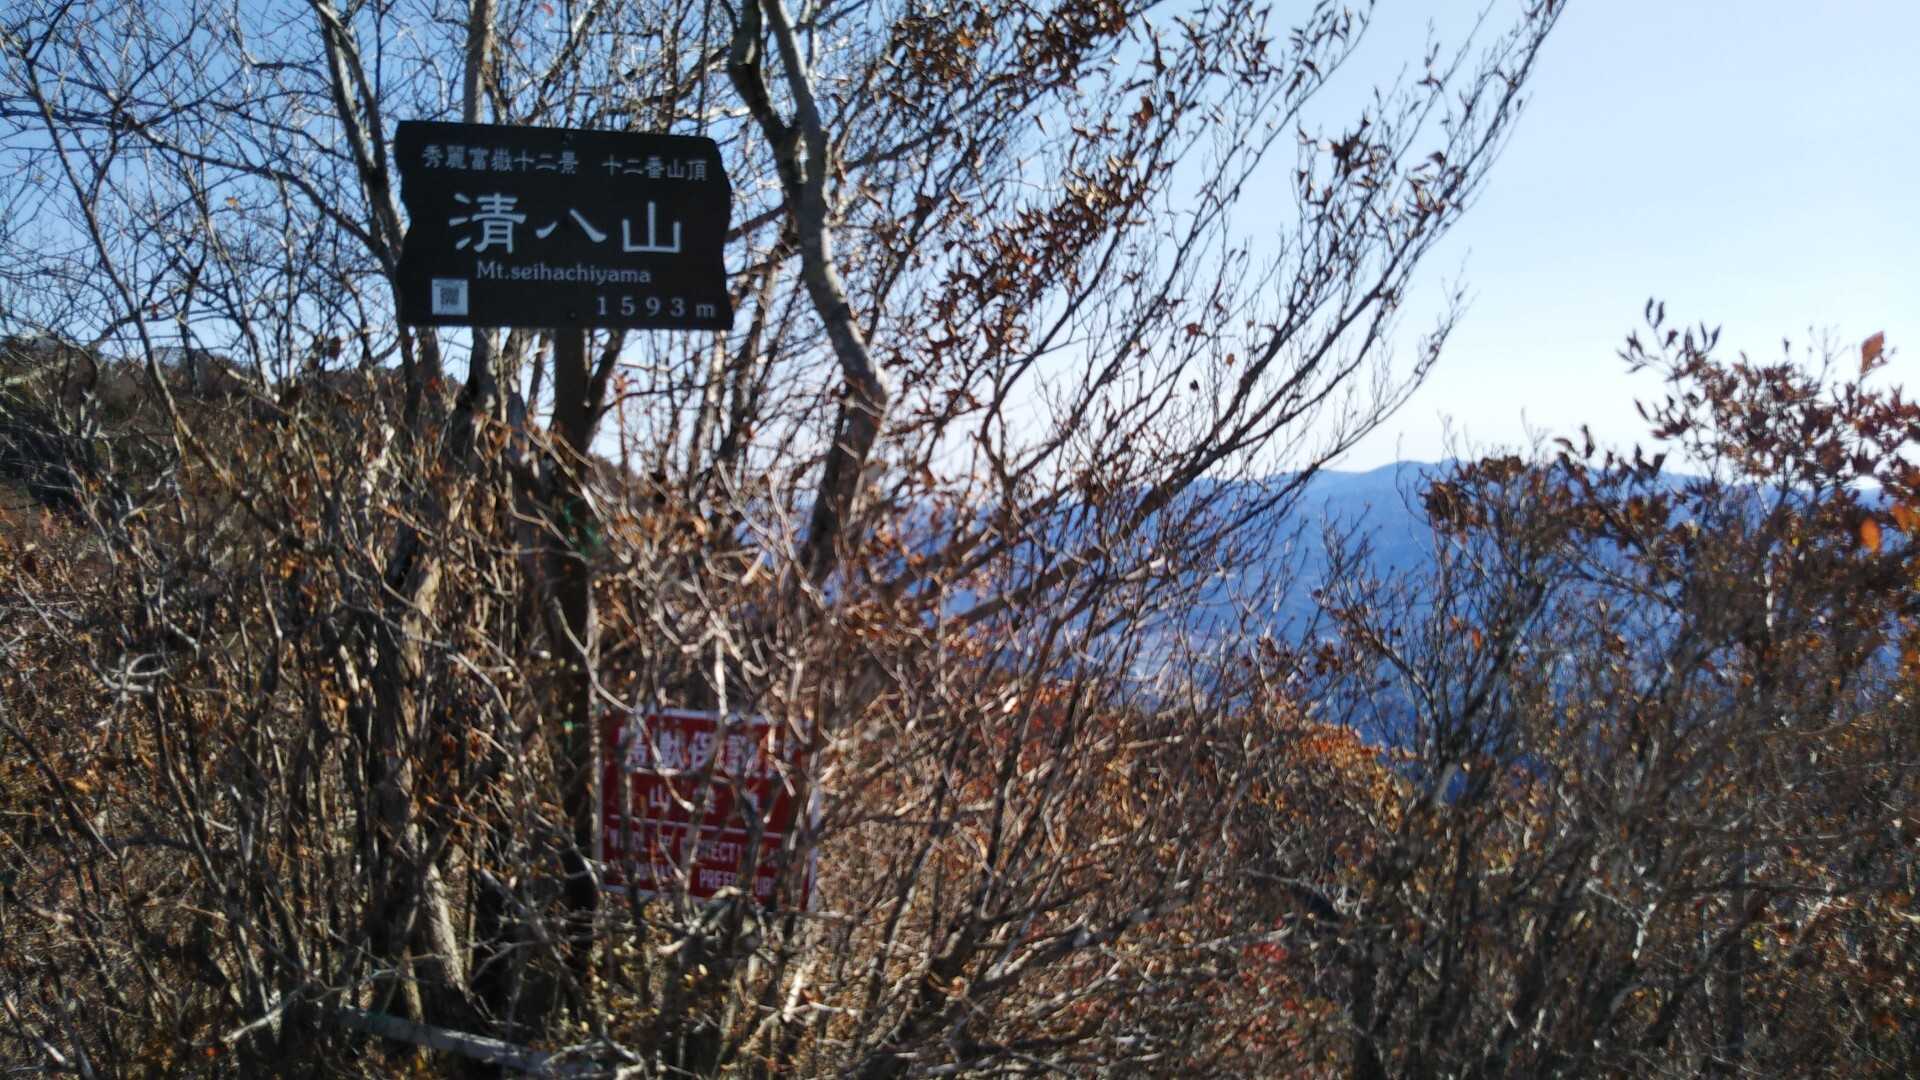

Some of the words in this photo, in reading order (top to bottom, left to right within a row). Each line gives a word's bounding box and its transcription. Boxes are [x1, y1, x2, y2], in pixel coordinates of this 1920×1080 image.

[601, 154, 708, 182] 十二番山頂
[448, 191, 683, 254] 清八山
[475, 259, 652, 286] Mt.seihachiyama
